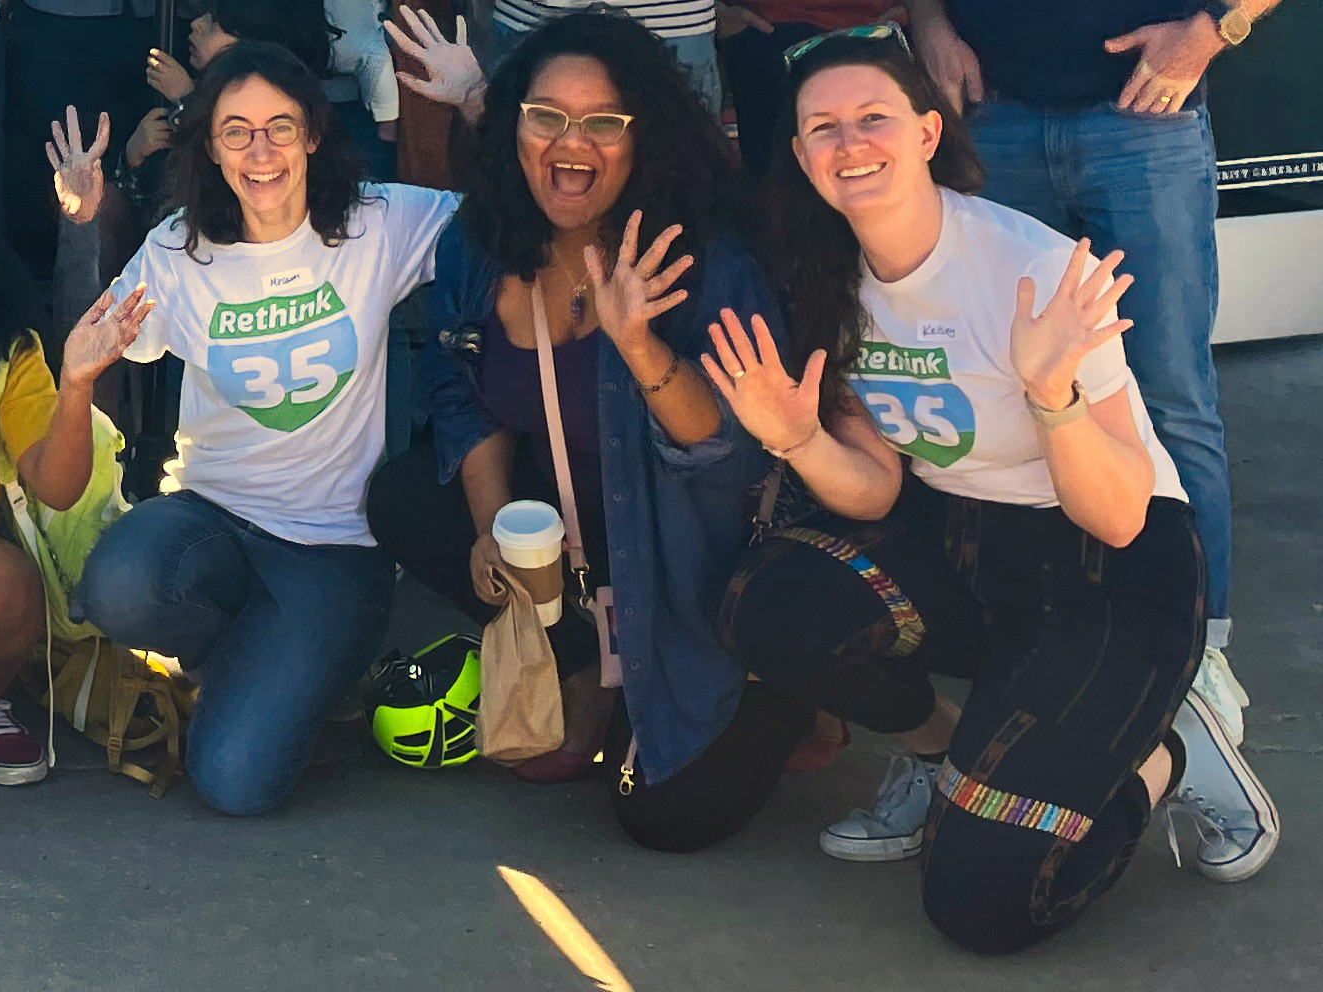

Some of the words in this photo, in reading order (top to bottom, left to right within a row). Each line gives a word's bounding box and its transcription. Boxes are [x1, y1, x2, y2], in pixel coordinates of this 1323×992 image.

[218, 289, 332, 335] Rethink
[231, 339, 339, 409] 35
[865, 392, 960, 447] 35
